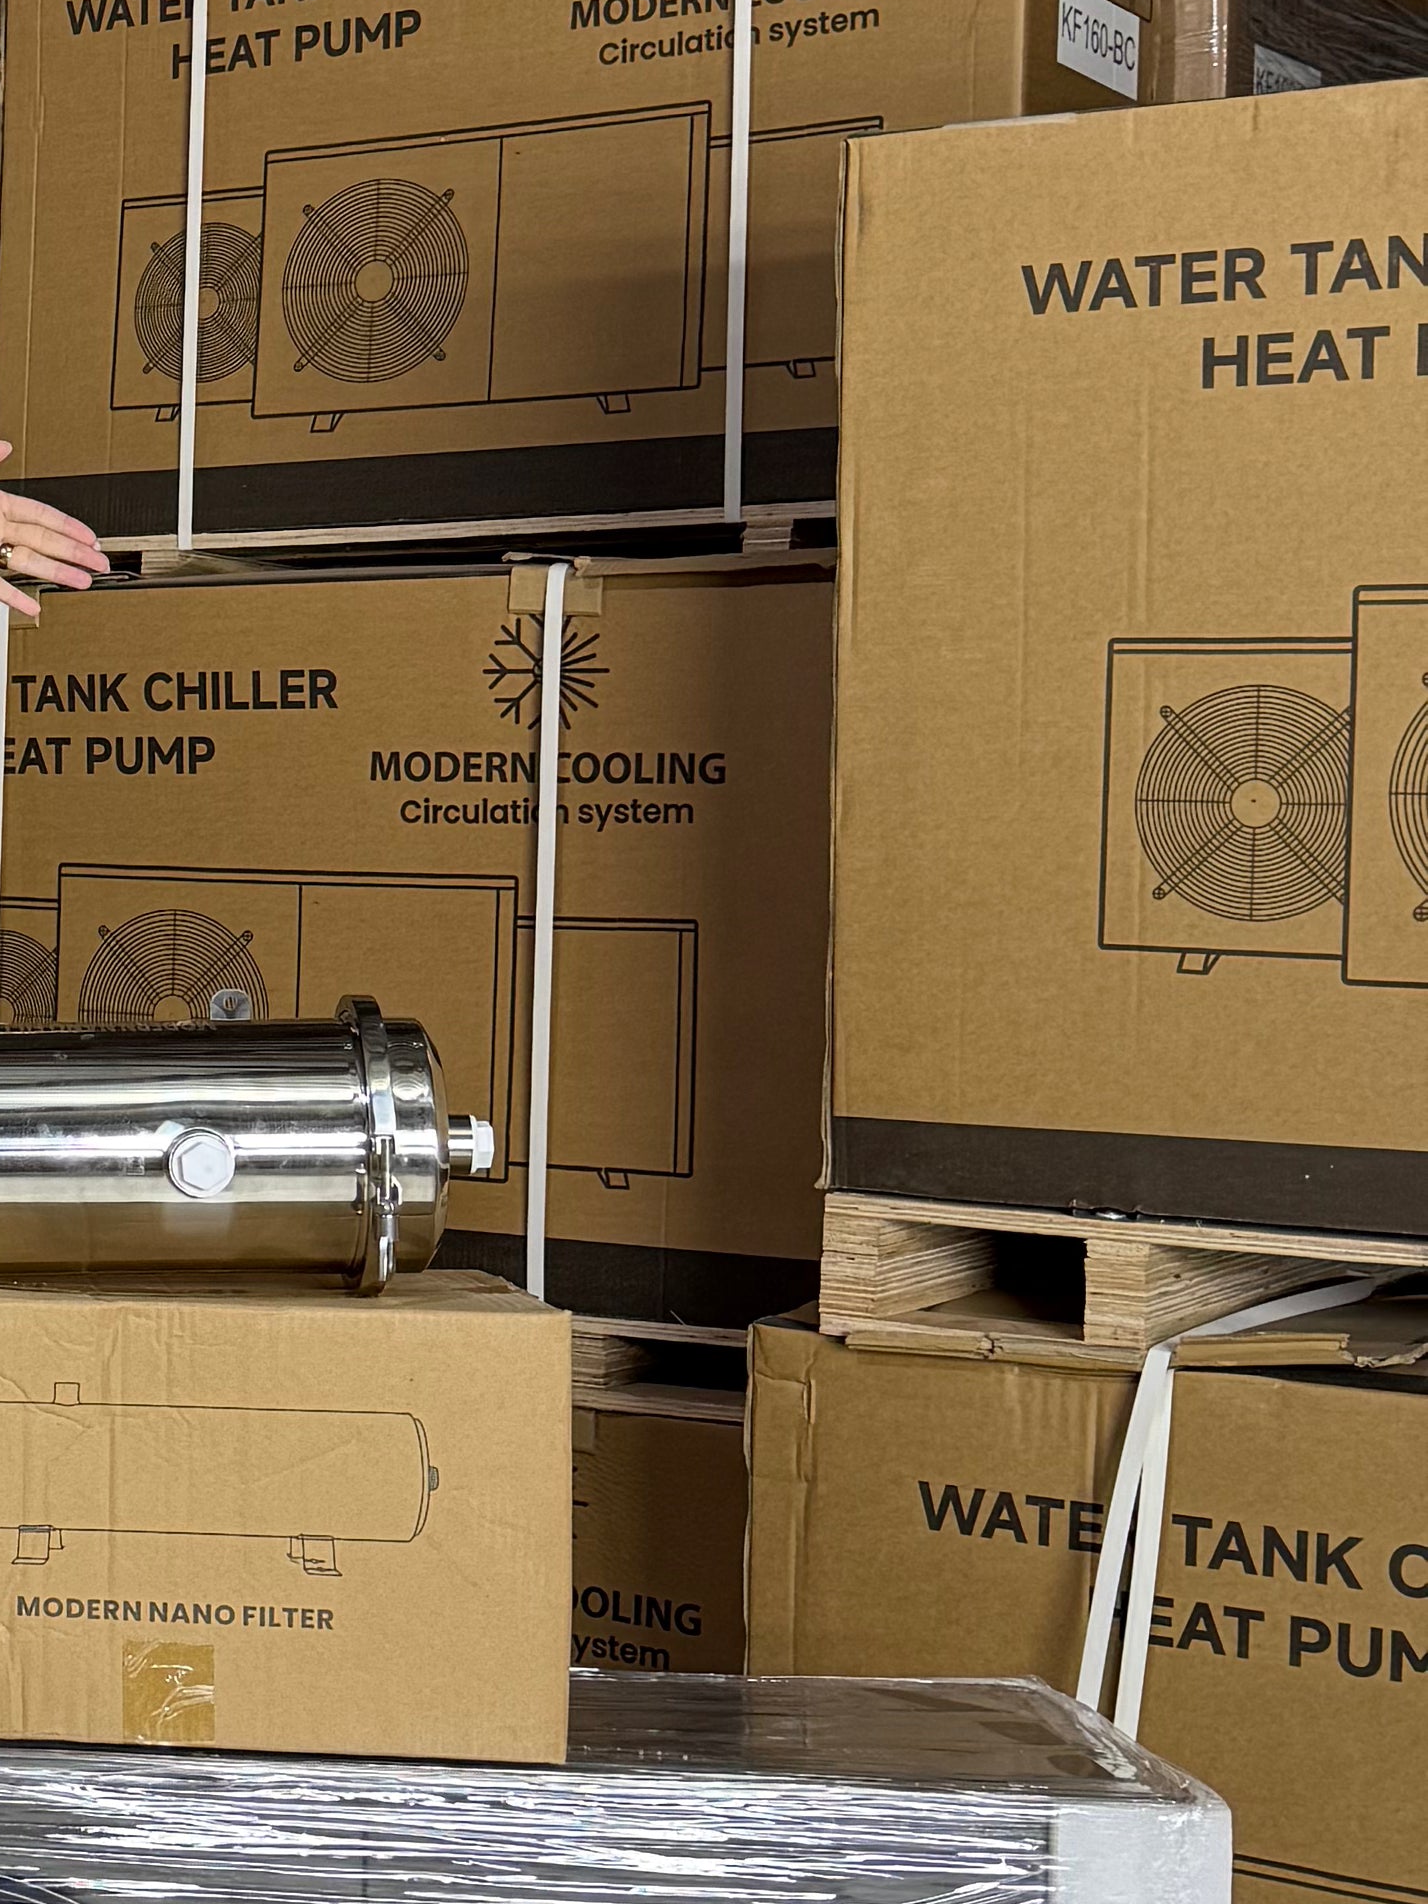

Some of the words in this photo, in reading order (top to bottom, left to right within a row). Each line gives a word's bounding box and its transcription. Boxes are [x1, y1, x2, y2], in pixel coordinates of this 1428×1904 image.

[294, 9, 422, 62] PUMP
[769, 8, 880, 47] system
[1061, 2, 1136, 72] KF160-BC
[1021, 246, 1267, 316] WATER
[1202, 325, 1391, 389] HEAT
[11, 672, 130, 713] TANK
[144, 669, 339, 712] CHILLER
[86, 736, 216, 775] PUMP
[370, 750, 537, 783] MODERN
[578, 798, 695, 833] system
[917, 1480, 1107, 1555] WATE
[1171, 1513, 1363, 1590] TANK
[16, 1596, 142, 1621] MODERN
[149, 1601, 235, 1625] NANO
[243, 1606, 334, 1630] FILTER
